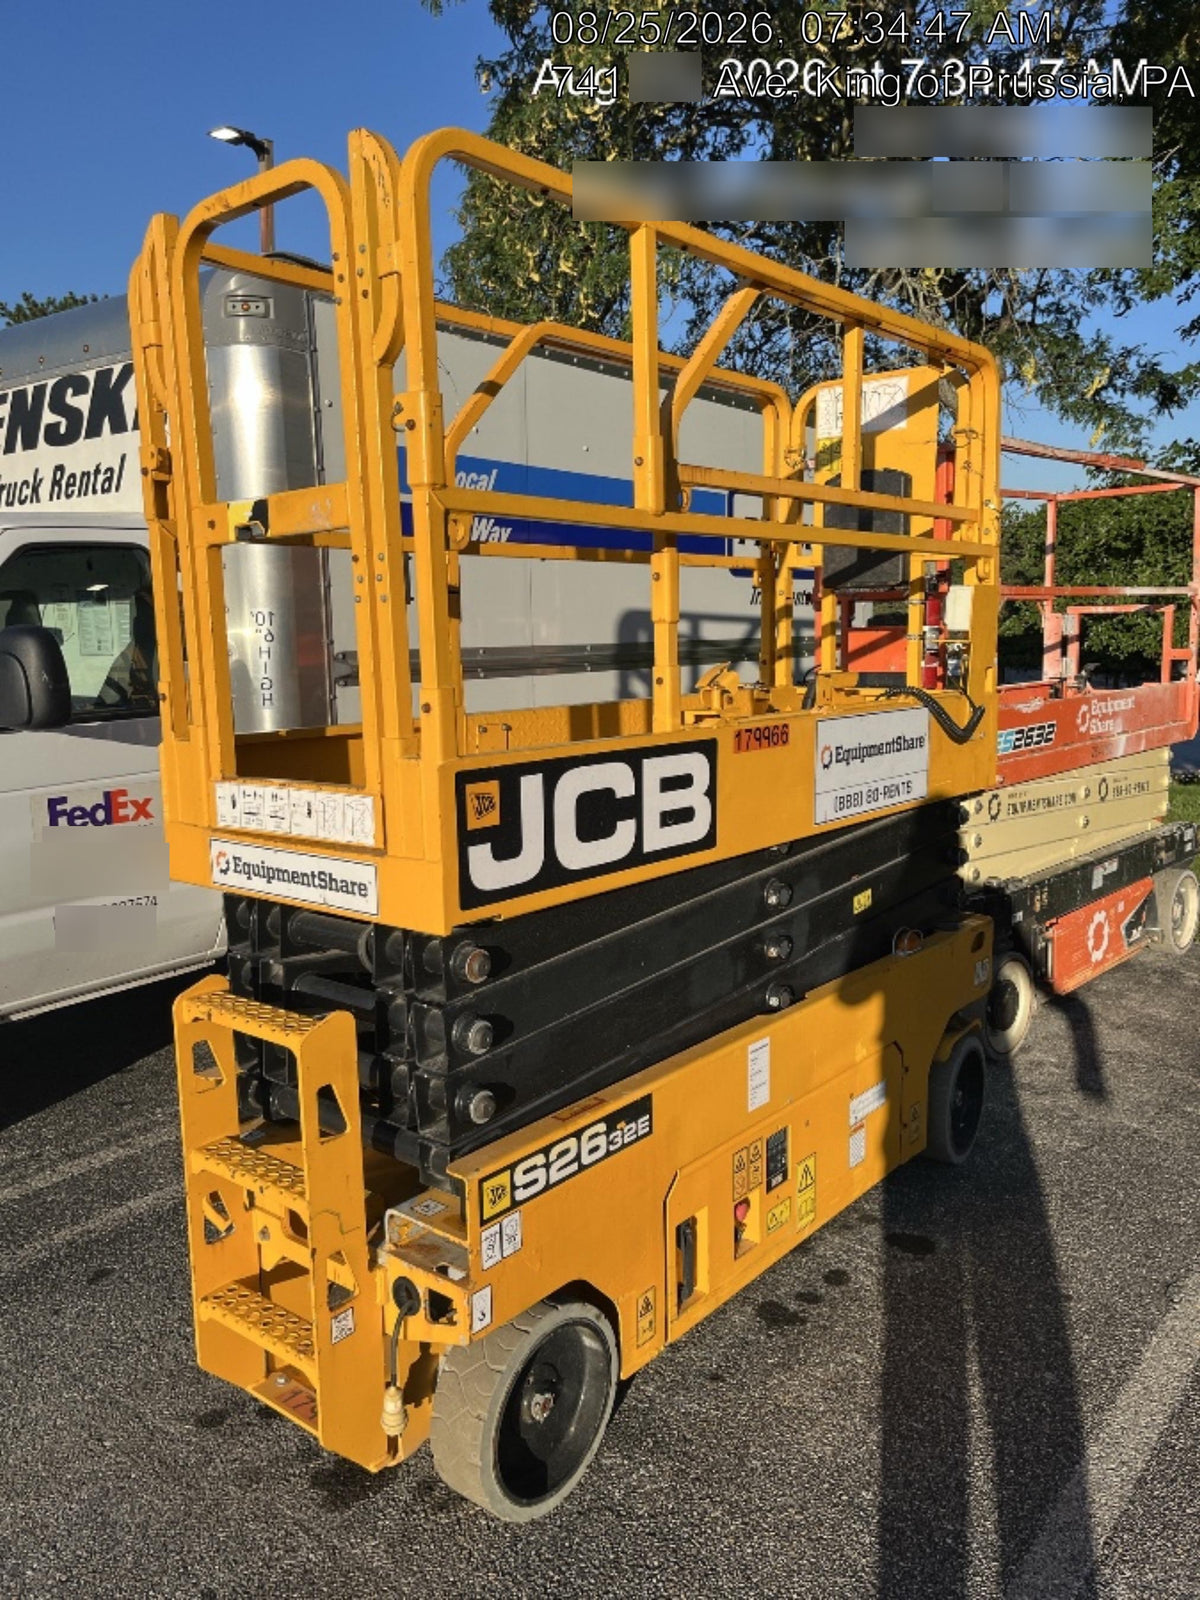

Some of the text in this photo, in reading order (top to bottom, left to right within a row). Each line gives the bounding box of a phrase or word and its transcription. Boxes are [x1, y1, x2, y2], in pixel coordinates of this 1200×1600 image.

[0, 362, 139, 455] NSK
[0, 453, 126, 507] ruck Rental
[455, 468, 498, 491] ocal
[1091, 696, 1136, 717] Equipment
[735, 724, 789, 752] 179966
[835, 735, 925, 765] EquipmentShare
[47, 789, 154, 826] FedEx
[468, 752, 712, 891] JCB
[232, 856, 368, 897] EquipmentShare
